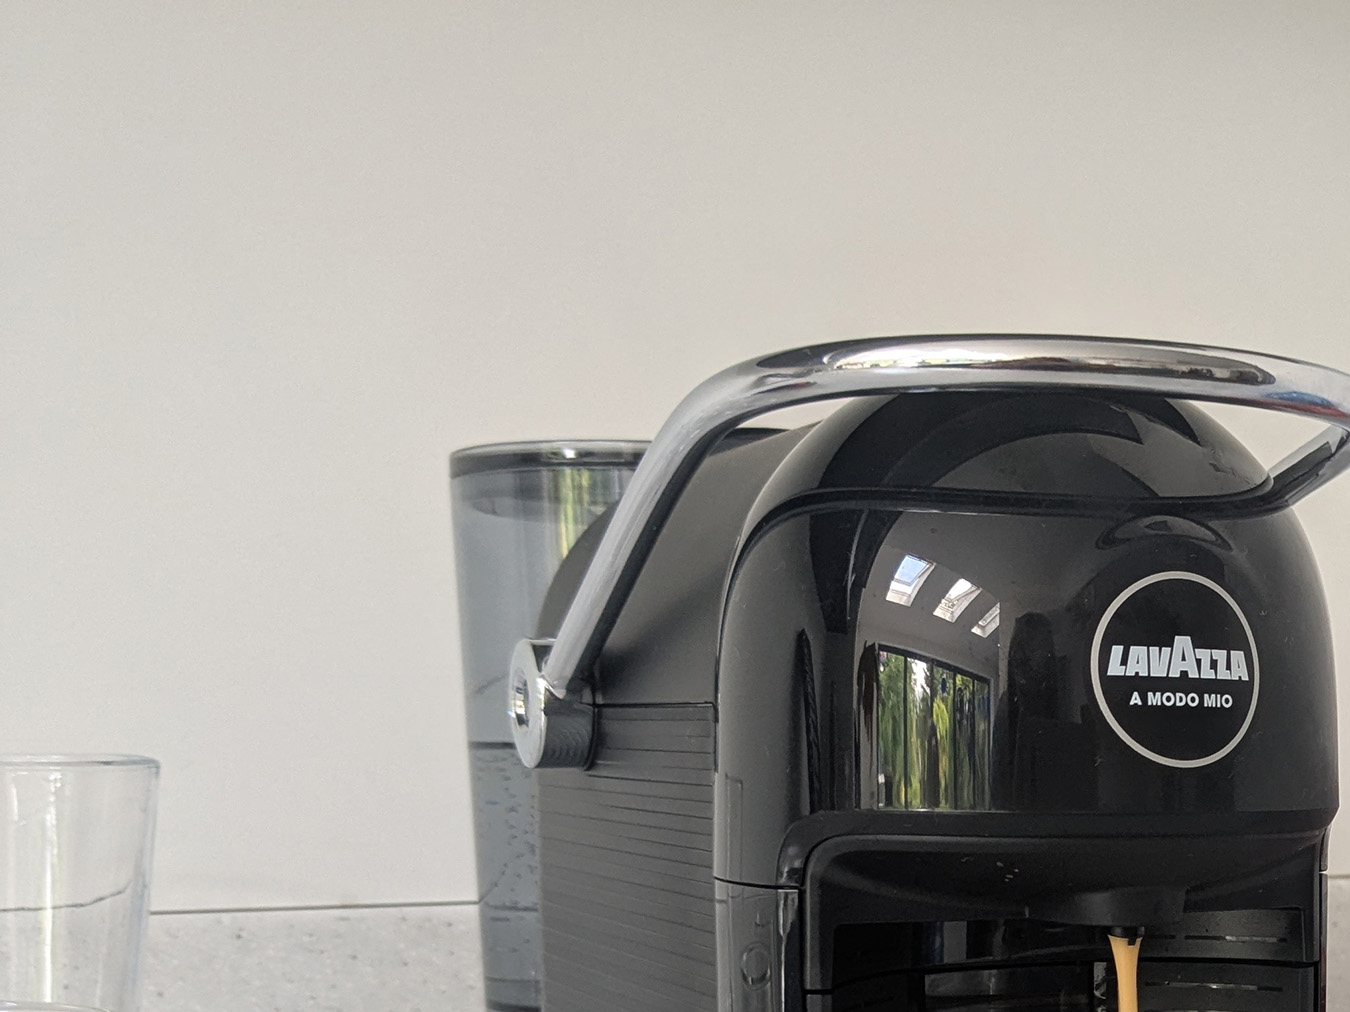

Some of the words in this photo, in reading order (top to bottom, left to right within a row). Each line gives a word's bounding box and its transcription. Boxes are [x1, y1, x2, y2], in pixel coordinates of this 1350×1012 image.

[1107, 635, 1249, 681] LAVAZZA
[1129, 691, 1142, 706] A
[1147, 691, 1199, 707] MODO
[1203, 693, 1233, 708] MIO
